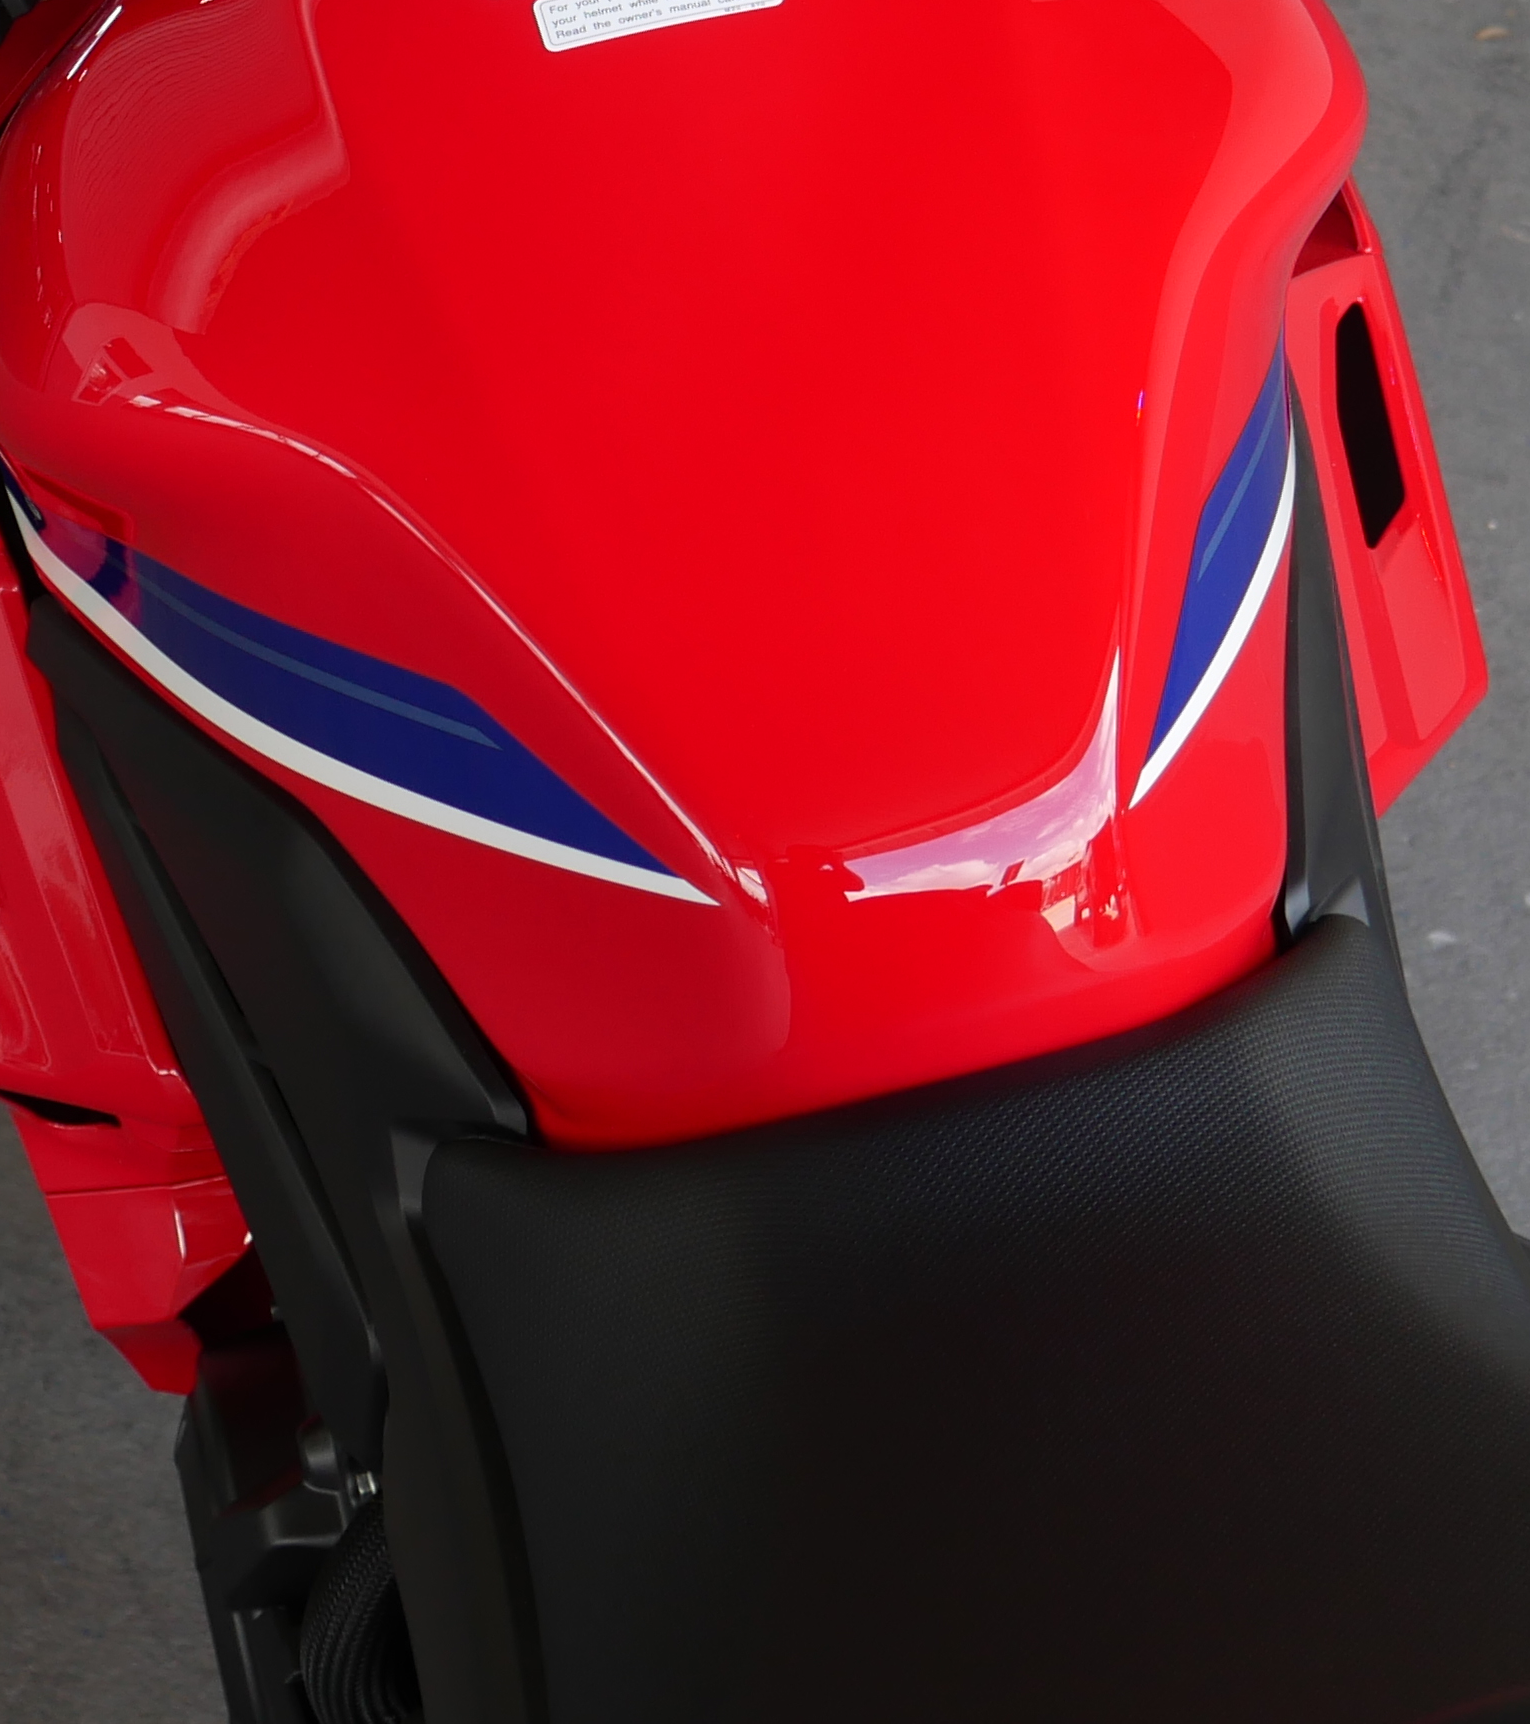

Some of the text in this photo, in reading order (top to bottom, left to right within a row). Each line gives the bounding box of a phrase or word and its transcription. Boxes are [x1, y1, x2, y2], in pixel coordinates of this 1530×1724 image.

[549, 3, 568, 14] For
[552, 16, 577, 29] your
[584, 4, 623, 20] helmet
[555, 25, 587, 39] Read
[593, 18, 612, 30] the
[618, 8, 663, 25] owner's
